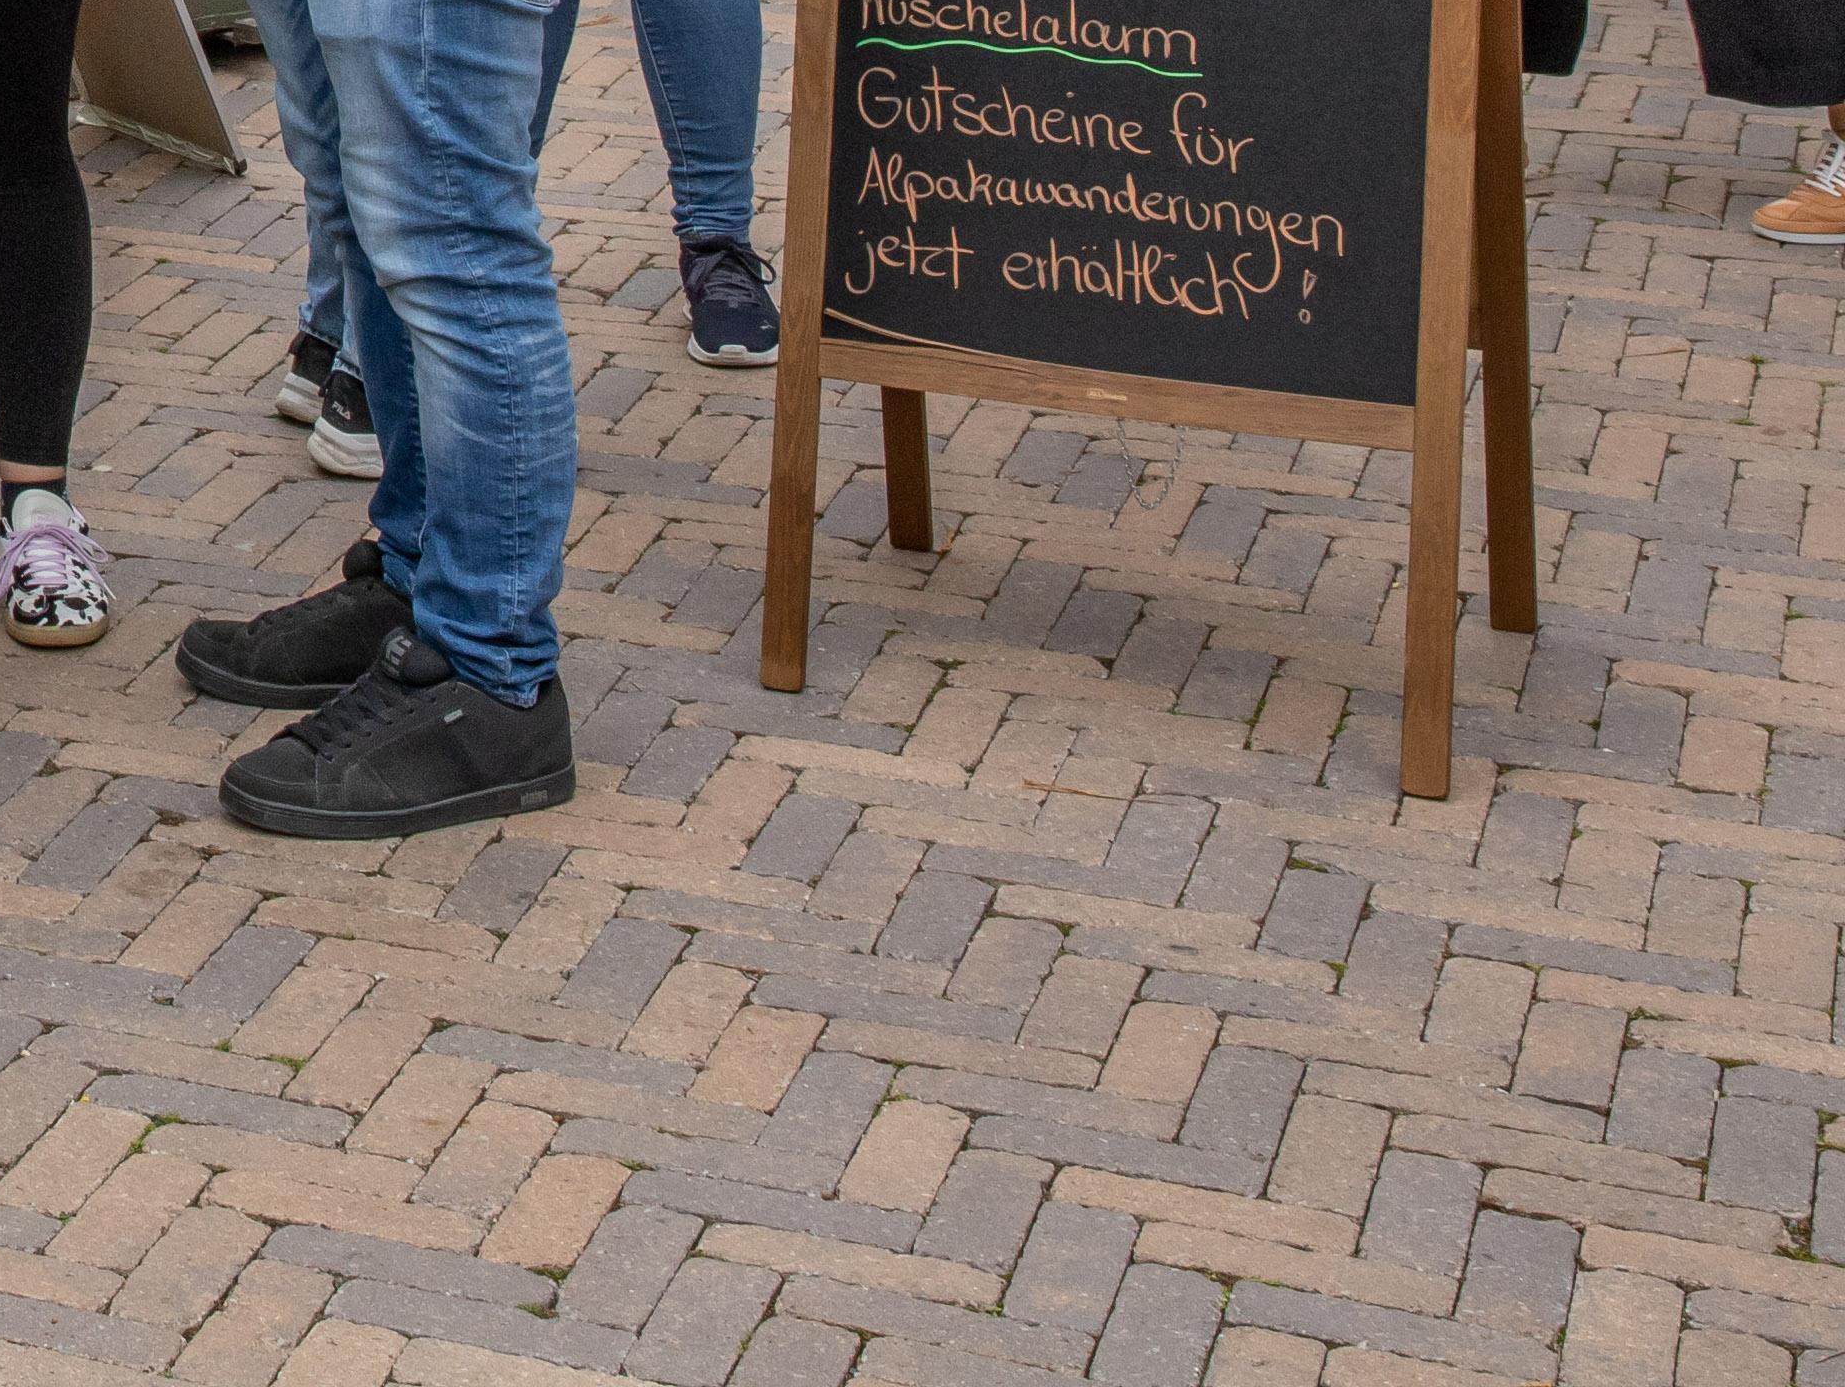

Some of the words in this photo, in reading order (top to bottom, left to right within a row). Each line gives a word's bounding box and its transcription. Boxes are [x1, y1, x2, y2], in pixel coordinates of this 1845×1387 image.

[857, 66, 1153, 158] Gutscheine
[1170, 91, 1254, 174] für
[845, 226, 975, 295] jetzt
[858, 146, 1345, 293] Alpakawanderungen
[331, 400, 351, 420] FILA
